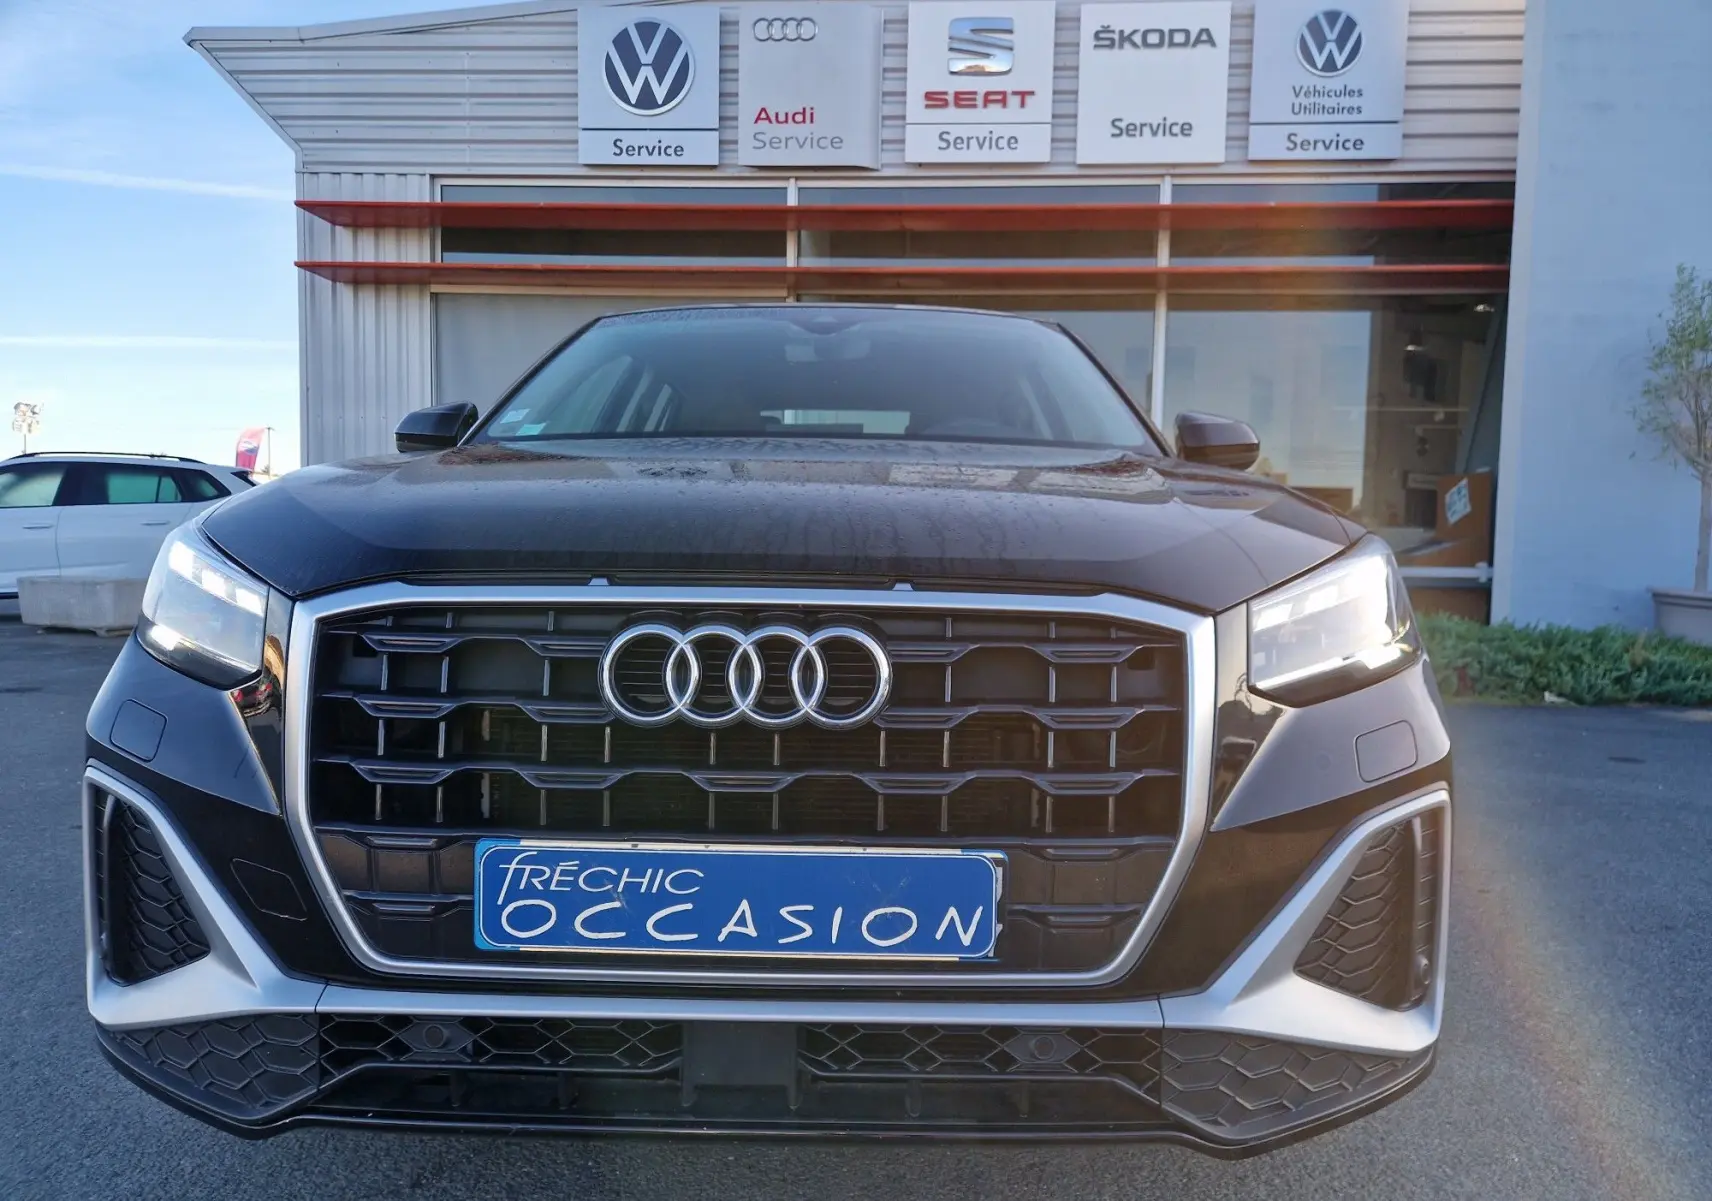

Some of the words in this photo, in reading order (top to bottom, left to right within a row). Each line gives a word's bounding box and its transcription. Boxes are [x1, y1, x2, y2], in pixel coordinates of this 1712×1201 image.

[1093, 25, 1217, 50] ŠKODA
[924, 90, 1035, 109] SEAT
[1292, 85, 1363, 99] Véhicules
[754, 107, 815, 125] Audi
[1291, 102, 1363, 116] Utilitaires
[1110, 117, 1193, 139] Service
[612, 139, 684, 157] Service
[752, 132, 844, 150] Service
[938, 130, 1019, 151] Service
[1286, 133, 1365, 152] Service
[501, 899, 984, 947] OCCASION
